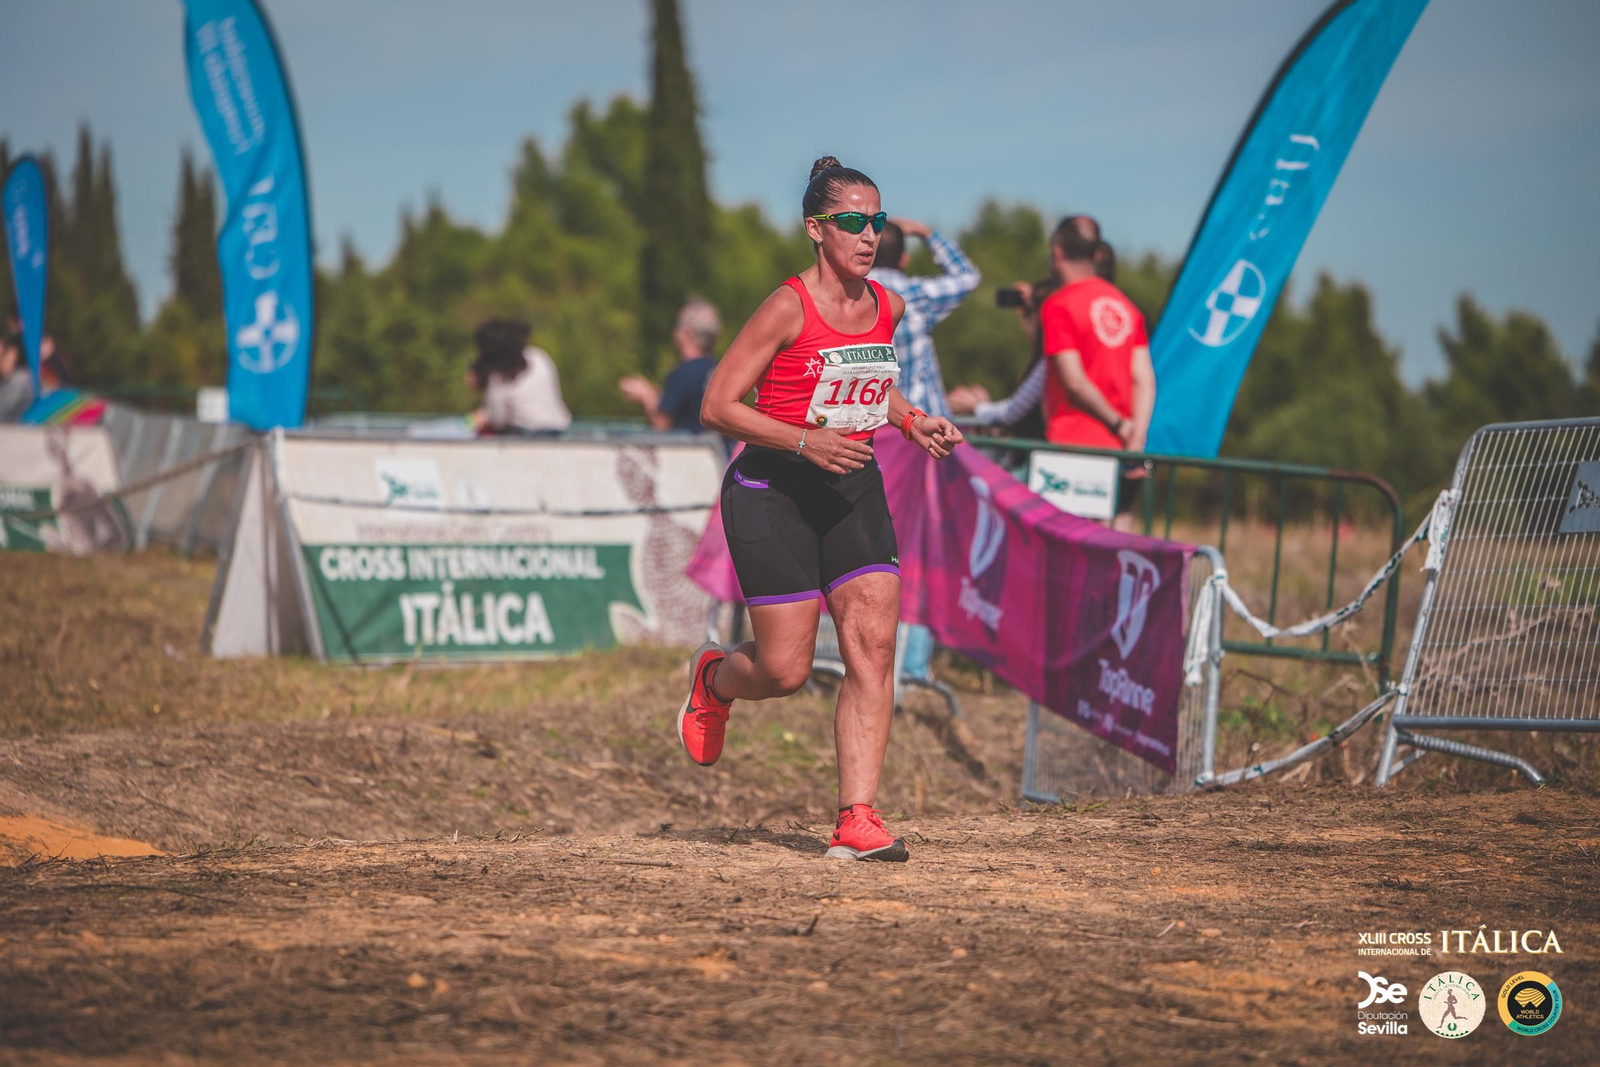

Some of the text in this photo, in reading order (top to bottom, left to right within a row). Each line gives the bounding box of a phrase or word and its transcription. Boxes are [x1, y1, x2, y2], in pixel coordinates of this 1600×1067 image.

[846, 348, 884, 361] ITÁLICA
[823, 377, 893, 406] 1168
[319, 547, 605, 580] CROSS INTERNACIONAL
[400, 580, 554, 645] ITÁLICA
